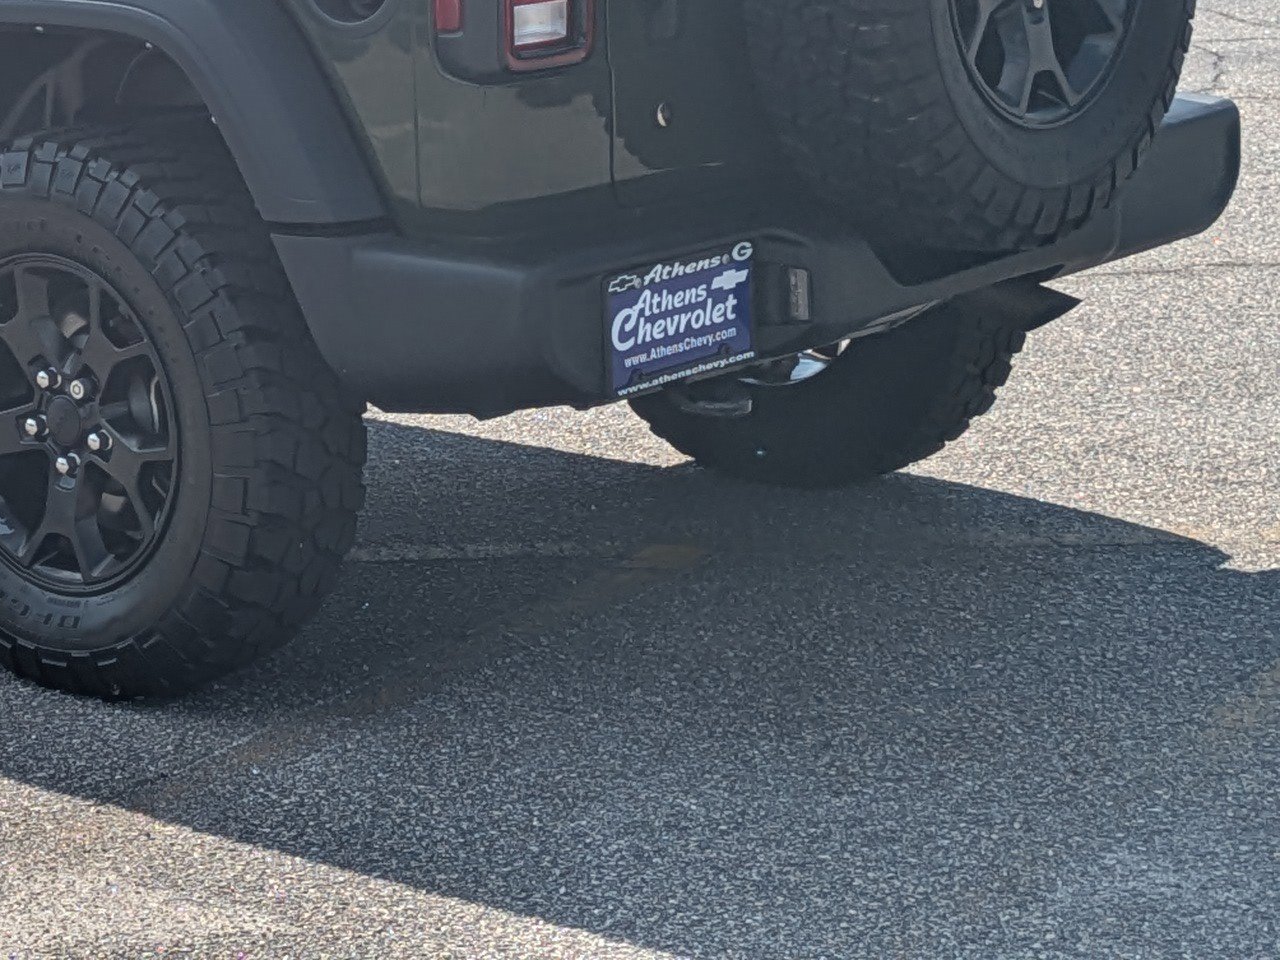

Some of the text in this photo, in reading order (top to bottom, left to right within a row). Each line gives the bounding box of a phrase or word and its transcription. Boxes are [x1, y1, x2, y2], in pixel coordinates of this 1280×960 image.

[643, 241, 754, 287] Athens G
[611, 293, 738, 352] Chevrolet
[632, 283, 708, 317] Athens
[623, 326, 738, 369] www.AthensChevy.com
[616, 350, 756, 397] www.athenschevy.com
